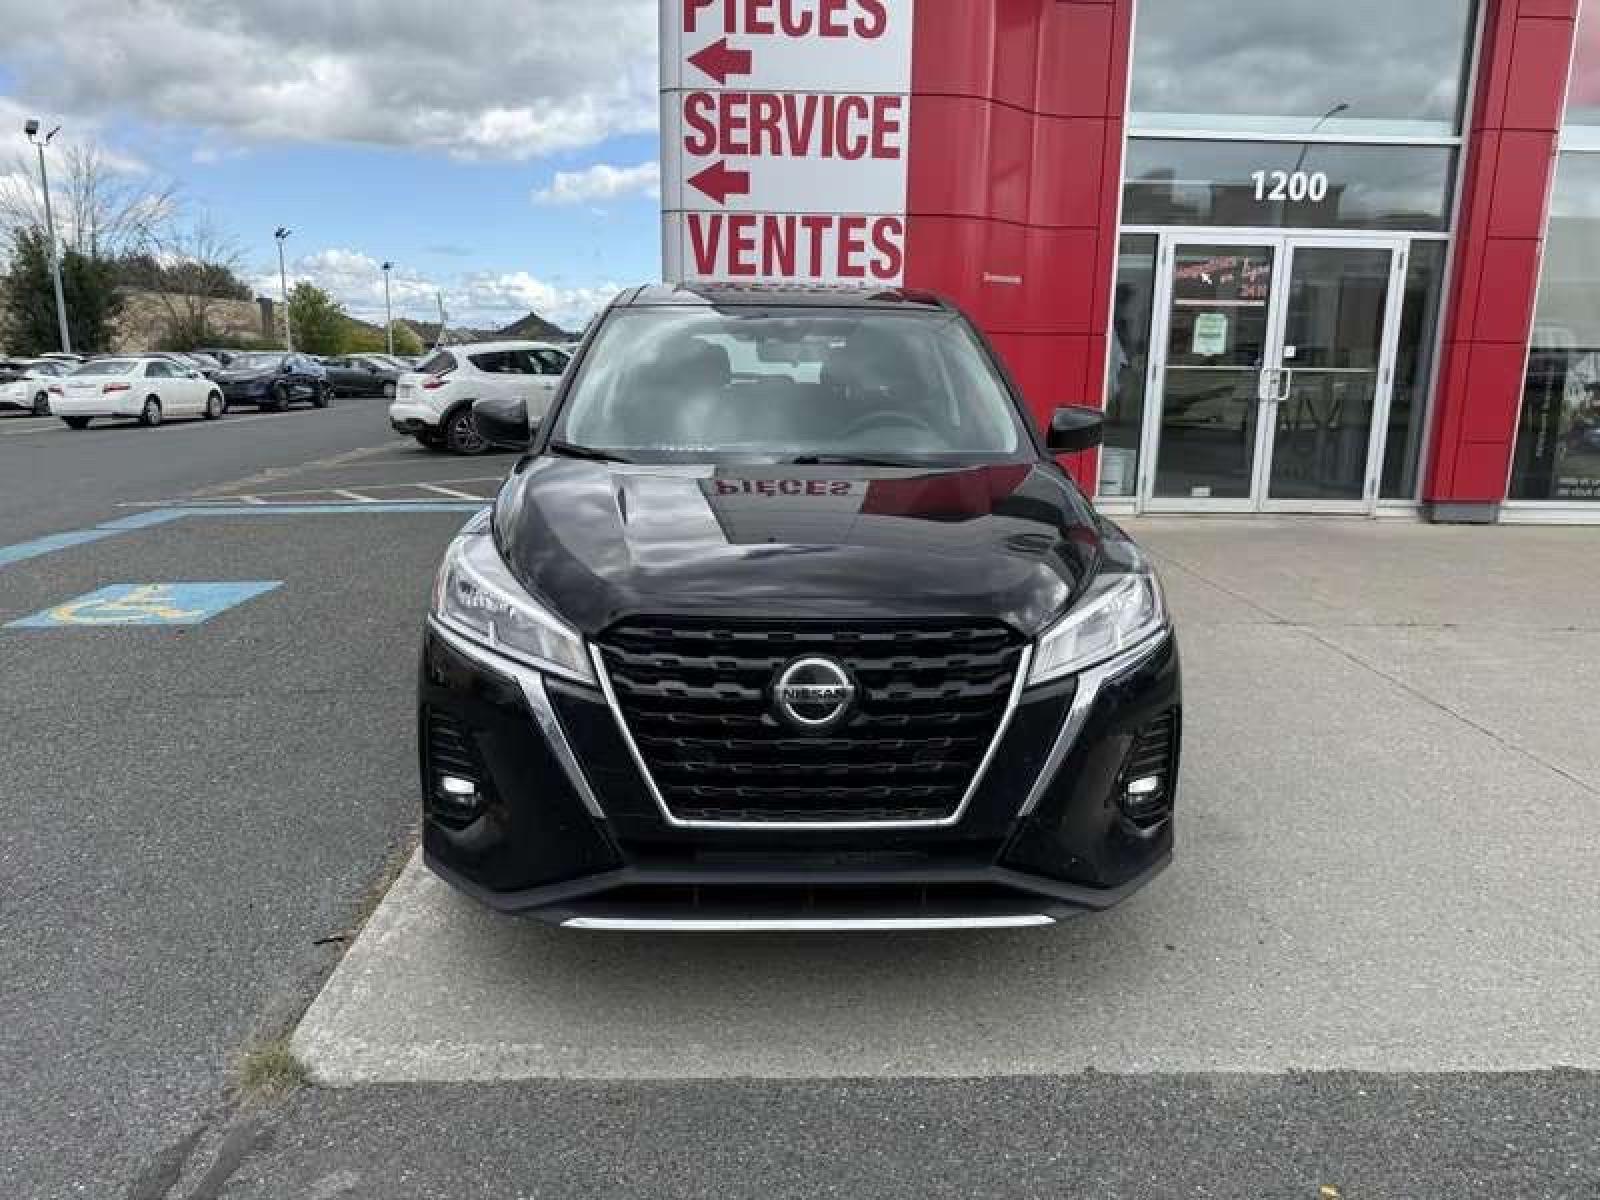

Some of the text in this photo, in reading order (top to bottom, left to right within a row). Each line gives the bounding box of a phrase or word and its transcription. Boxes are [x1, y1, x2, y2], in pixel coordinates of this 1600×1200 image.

[684, 92, 901, 160] SERVICE
[1250, 169, 1329, 202] 1200
[687, 213, 904, 279] VENTES
[783, 688, 846, 701] NISSAN
